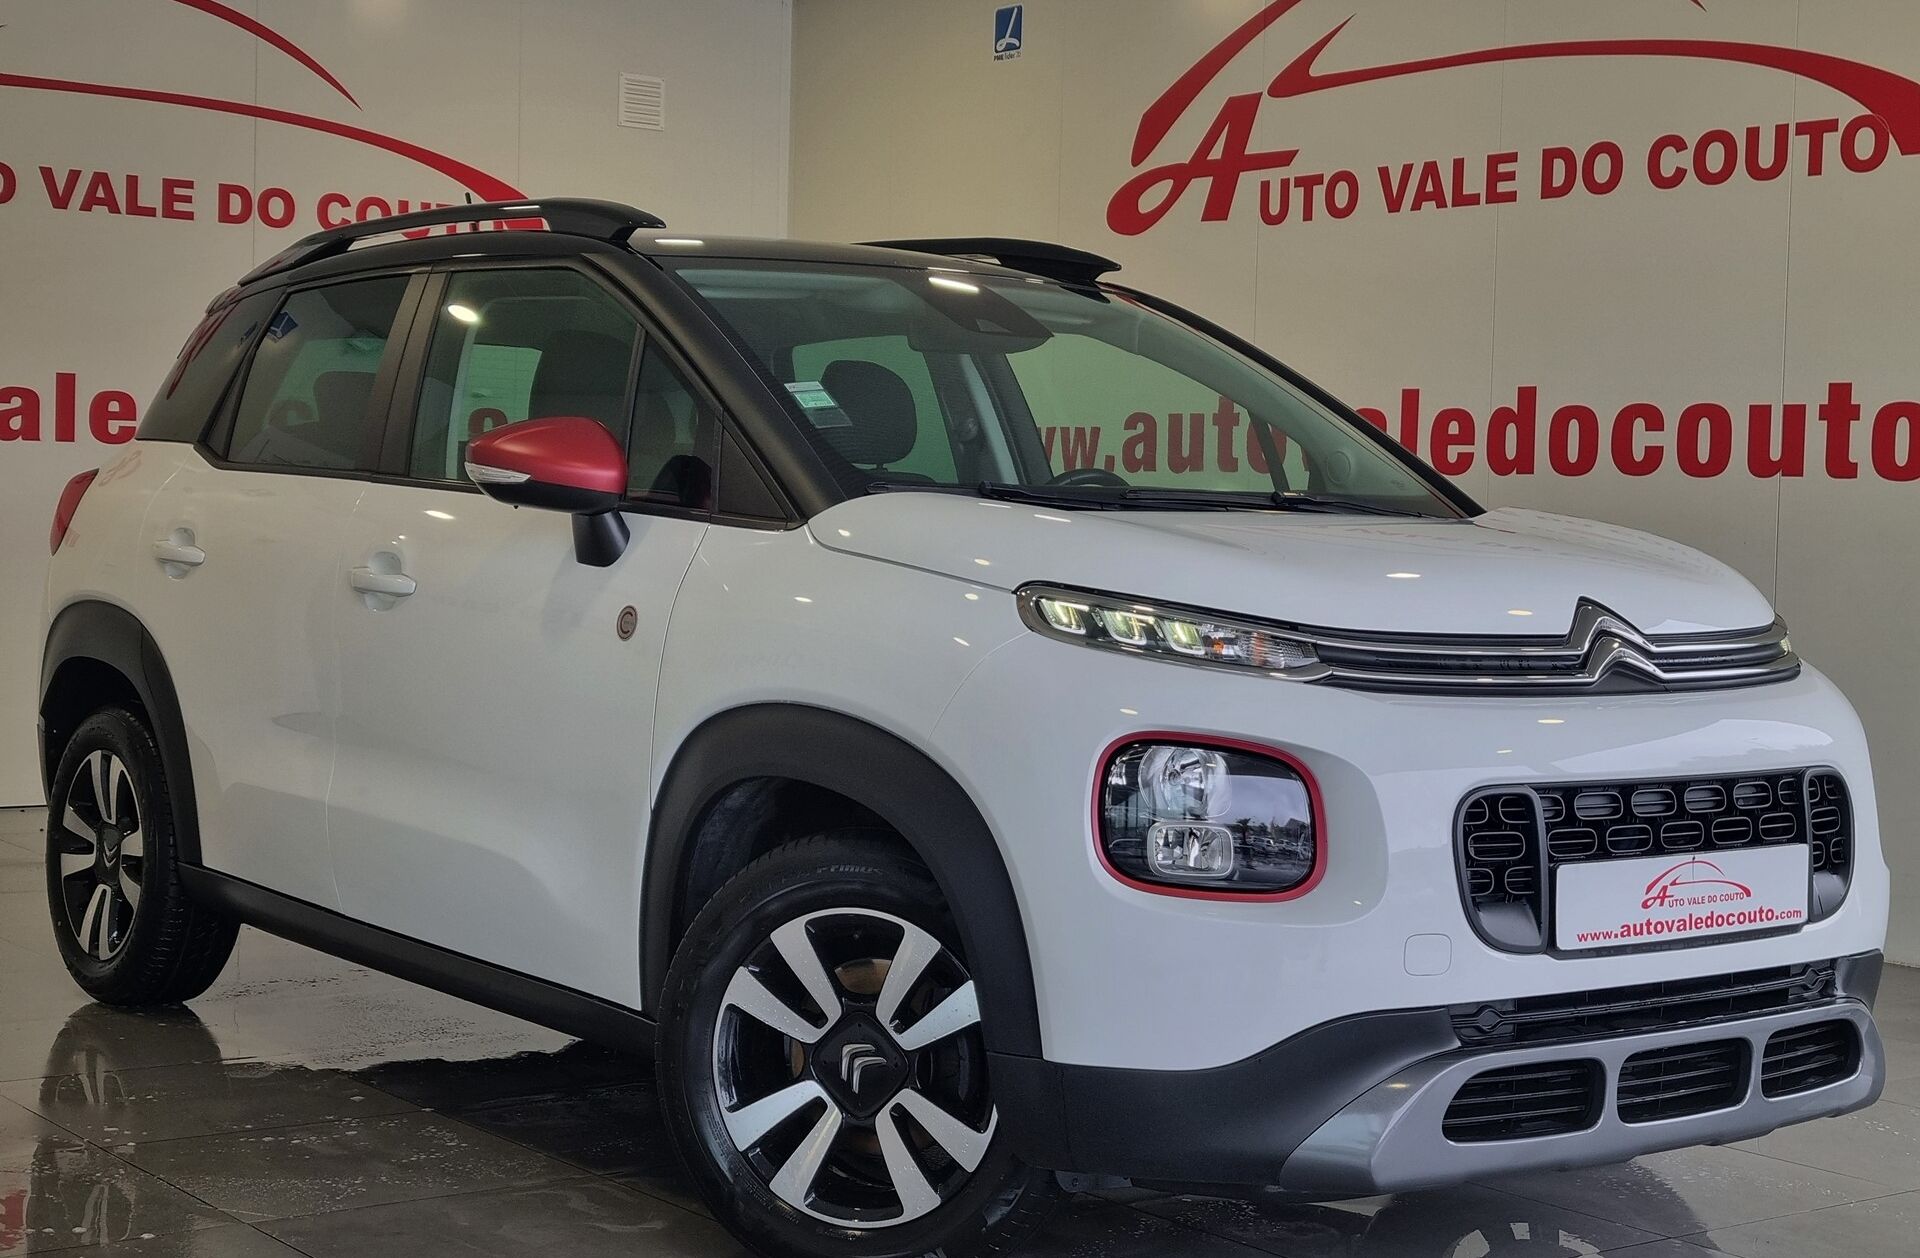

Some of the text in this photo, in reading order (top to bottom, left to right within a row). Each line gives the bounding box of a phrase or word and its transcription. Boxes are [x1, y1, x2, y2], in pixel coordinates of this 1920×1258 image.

[1106, 91, 1890, 236] AUTO VALE DO COUTO
[38, 165, 195, 221] VALE
[217, 182, 296, 229] DO
[316, 192, 503, 239] COU
[1576, 905, 1802, 943] www.autovaledocouto.com
[1641, 884, 1745, 909] AUTO VALE DO COUTO
